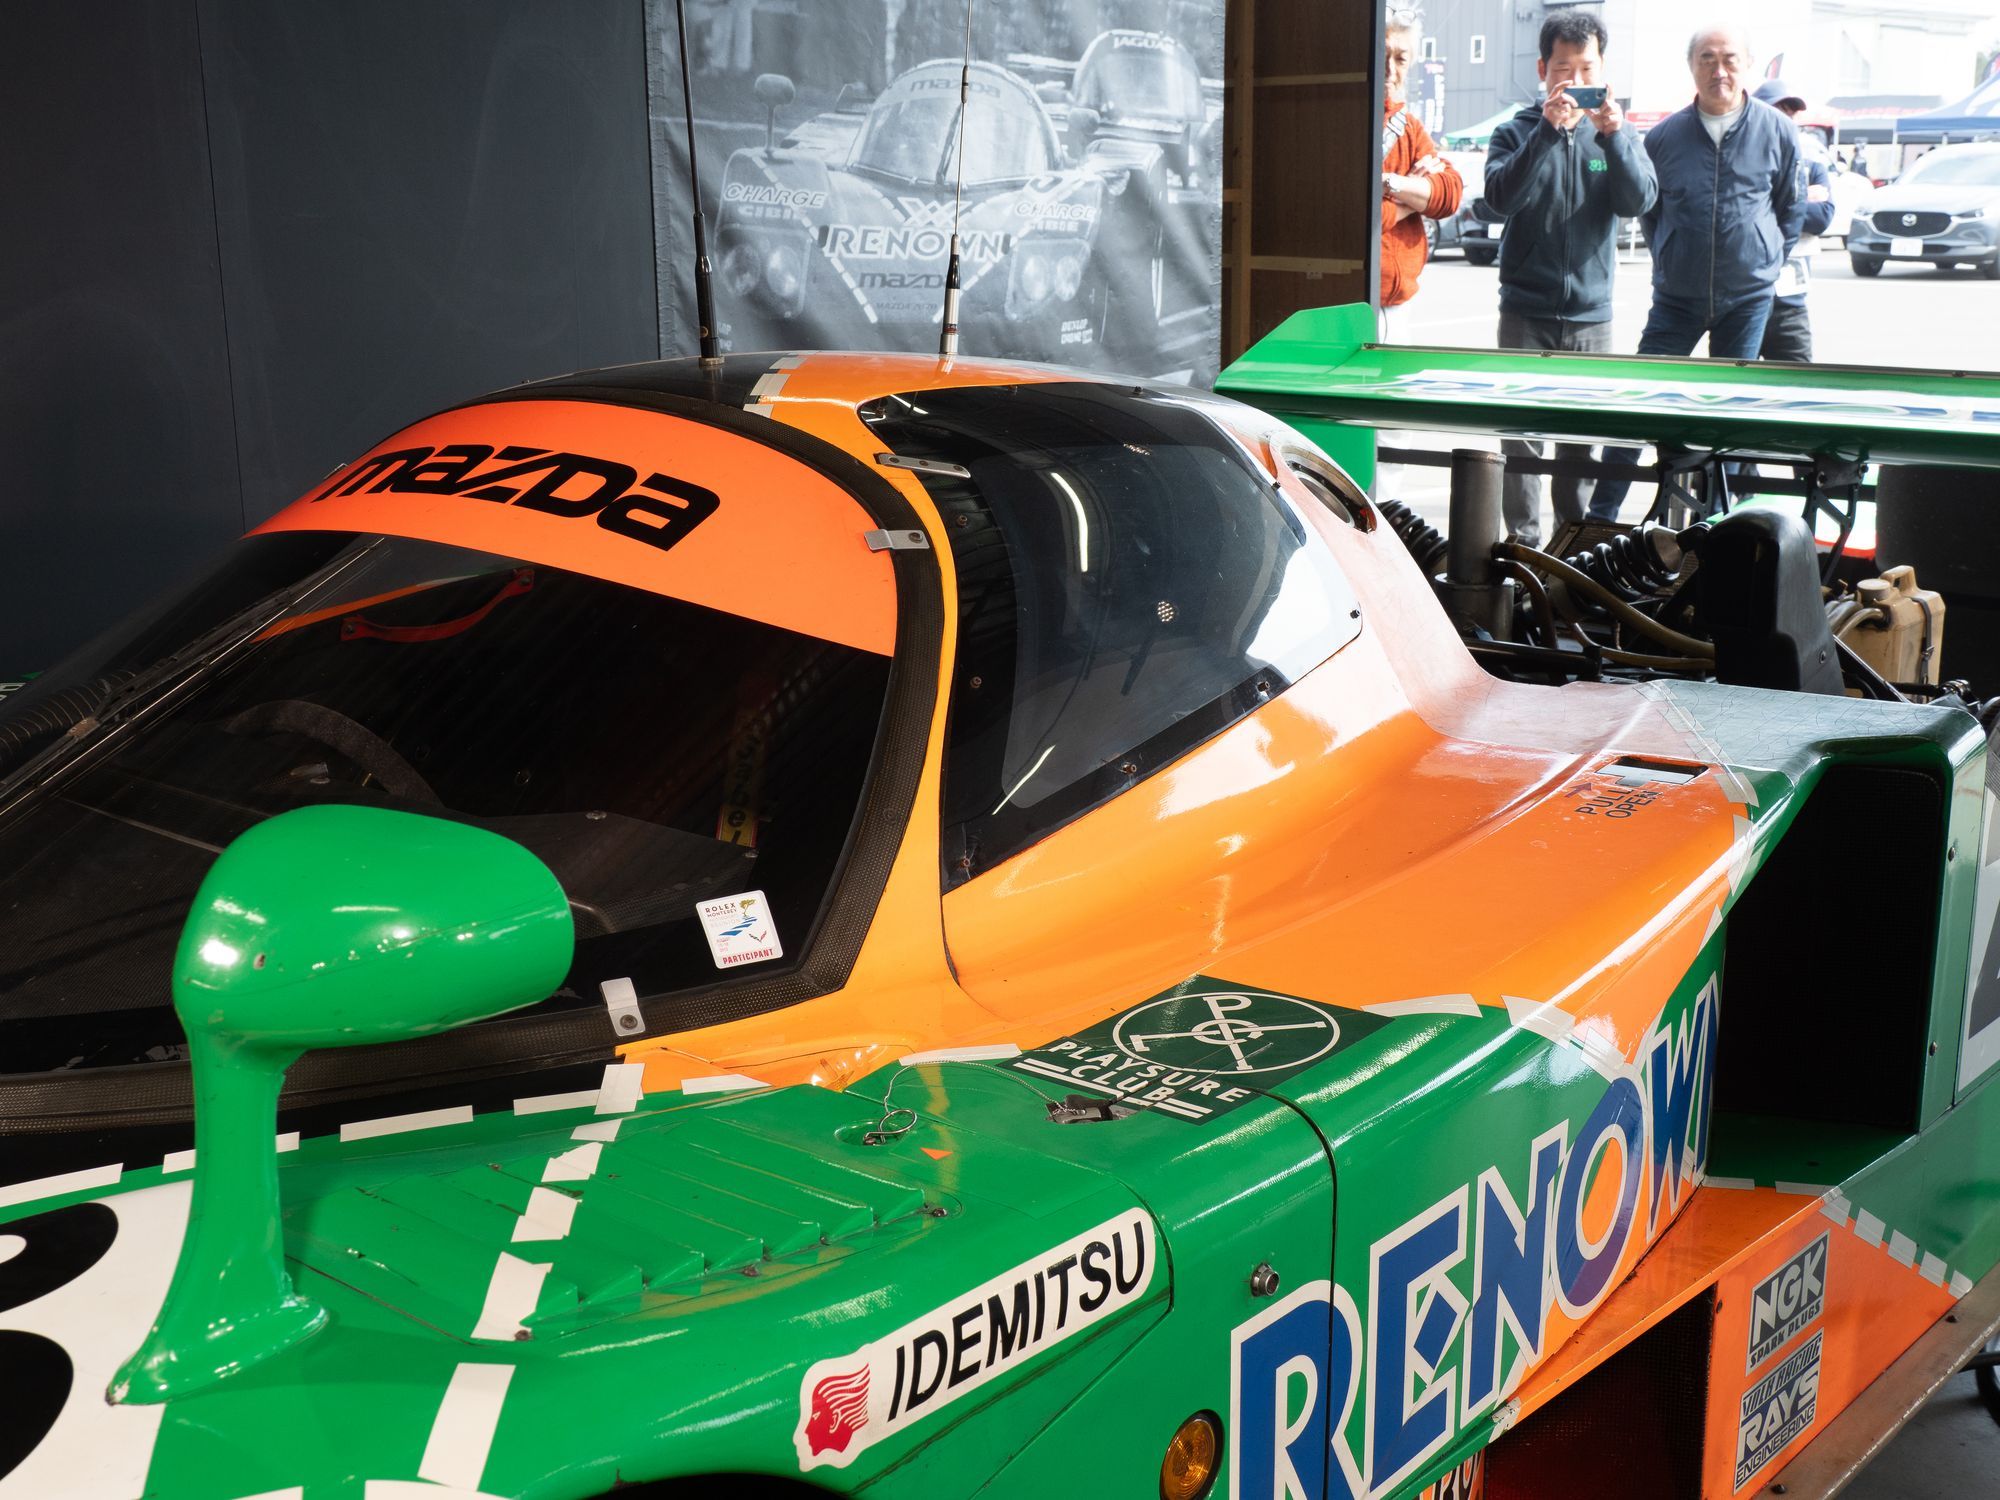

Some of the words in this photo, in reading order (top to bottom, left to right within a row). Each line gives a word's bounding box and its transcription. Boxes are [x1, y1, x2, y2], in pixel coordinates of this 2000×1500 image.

[724, 183, 827, 208] CHARGE
[1016, 201, 1096, 221] CHARGE
[824, 224, 1004, 263] RENOWN
[859, 272, 945, 289] mazd
[310, 444, 720, 552] mazda
[1574, 789, 1634, 815] PULL
[1605, 790, 1659, 819] OPEN
[705, 902, 736, 913] ROLEX
[707, 909, 737, 918] MONTEREY
[722, 948, 774, 965] PARTICIPANT
[1048, 1040, 1252, 1103] PLAYSURE
[1070, 1064, 1176, 1102] CLUB
[1752, 1240, 1825, 1345] NGK
[887, 1221, 1146, 1423] IDEMITSU
[1750, 1329, 1785, 1368] SPARK
[1788, 1300, 1821, 1337] PLUGS
[1737, 1362, 1820, 1463] RAYS
[1736, 1402, 1815, 1484] ENGINEERING
